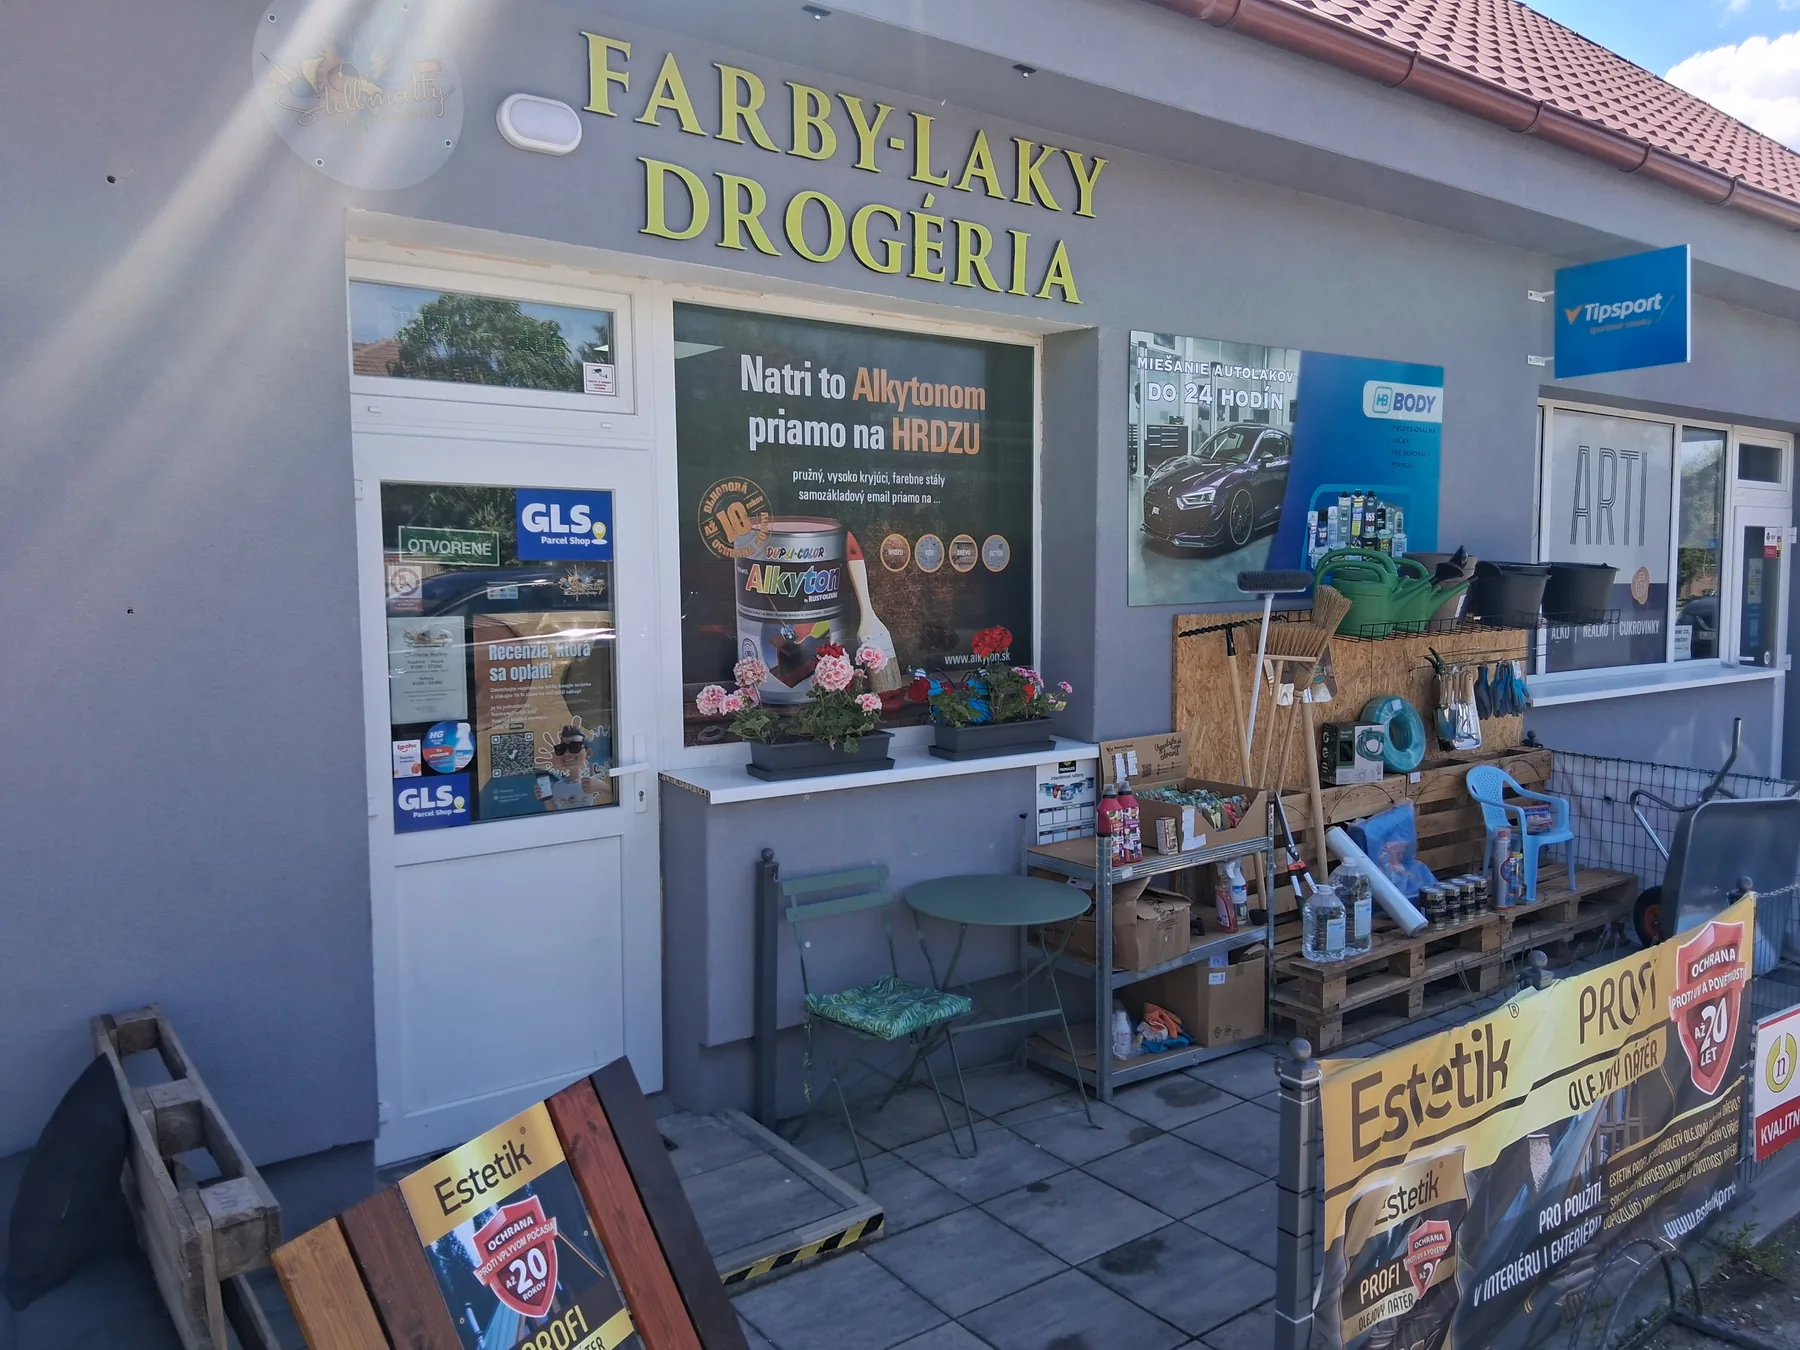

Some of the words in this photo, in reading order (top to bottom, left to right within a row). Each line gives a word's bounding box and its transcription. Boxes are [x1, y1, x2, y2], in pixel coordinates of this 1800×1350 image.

[581, 31, 1109, 219] FARBY-LAKY
[637, 156, 1083, 305] DROGÉRIA
[1585, 293, 1663, 323] Tipsport
[740, 353, 812, 398] Natri
[818, 365, 846, 399] to
[852, 366, 986, 412] Alkytonom
[1137, 355, 1209, 376] MIEŠANIE
[1214, 364, 1294, 384] AUTOLAKOV
[1148, 382, 1177, 402] DO
[1184, 381, 1213, 405] 24
[1221, 385, 1284, 411] HODÍN
[1393, 392, 1436, 414] BODY
[749, 408, 846, 451] priamo
[853, 424, 885, 450] na
[892, 417, 980, 455] HRDZU
[792, 468, 826, 483] pružný,
[827, 470, 858, 484] vysoko
[859, 470, 891, 486] kryjúci,
[892, 471, 924, 486] farebne
[925, 472, 945, 488] stály
[798, 488, 865, 504] samozákladový
[867, 491, 890, 503] email
[892, 492, 920, 505] priamo
[921, 494, 932, 504] na
[1570, 444, 1648, 546] ARTI
[522, 502, 592, 535] GLS
[716, 501, 752, 543] 10
[408, 538, 493, 557] OTVORENE
[541, 536, 567, 546] Parcel
[570, 536, 591, 547] Shop
[745, 563, 842, 598] Alkyton
[1619, 619, 1660, 636] CUKROVINKY
[489, 667, 507, 681] sa
[429, 730, 444, 739] HG
[398, 785, 453, 811] GLS
[413, 810, 435, 818] Parcel
[1691, 948, 1736, 978] OCHRANA
[1671, 991, 1692, 1011] PROTI
[1702, 982, 1708, 994] A
[1694, 1021, 1706, 1039] AŽ
[1700, 996, 1728, 1053] 20
[1624, 1036, 1658, 1081] NÁTĚR
[1700, 1046, 1718, 1067] LET
[1351, 1022, 1512, 1163] Estetik
[433, 1139, 533, 1217] Estetik
[1609, 1166, 1632, 1188] ESTETIK
[1540, 1203, 1561, 1234] PRO
[1564, 1175, 1602, 1222] POUŽITÍ
[487, 1216, 535, 1251] OCHRANA
[1414, 1233, 1445, 1250] OCHRANA
[478, 1259, 498, 1279] PROTI
[497, 1238, 527, 1264] VPLYVOM
[526, 1222, 555, 1244] POČASIA
[1473, 1283, 1483, 1307] V
[1483, 1249, 1541, 1302] INTERIÉRU
[1551, 1214, 1602, 1264] EXTERIÉRU
[505, 1276, 518, 1290] AŽ
[509, 1247, 548, 1295] 20
[1359, 1262, 1400, 1305] PROFI
[522, 1280, 547, 1301] ROKOV
[1387, 1290, 1414, 1317] NÁTĚR
